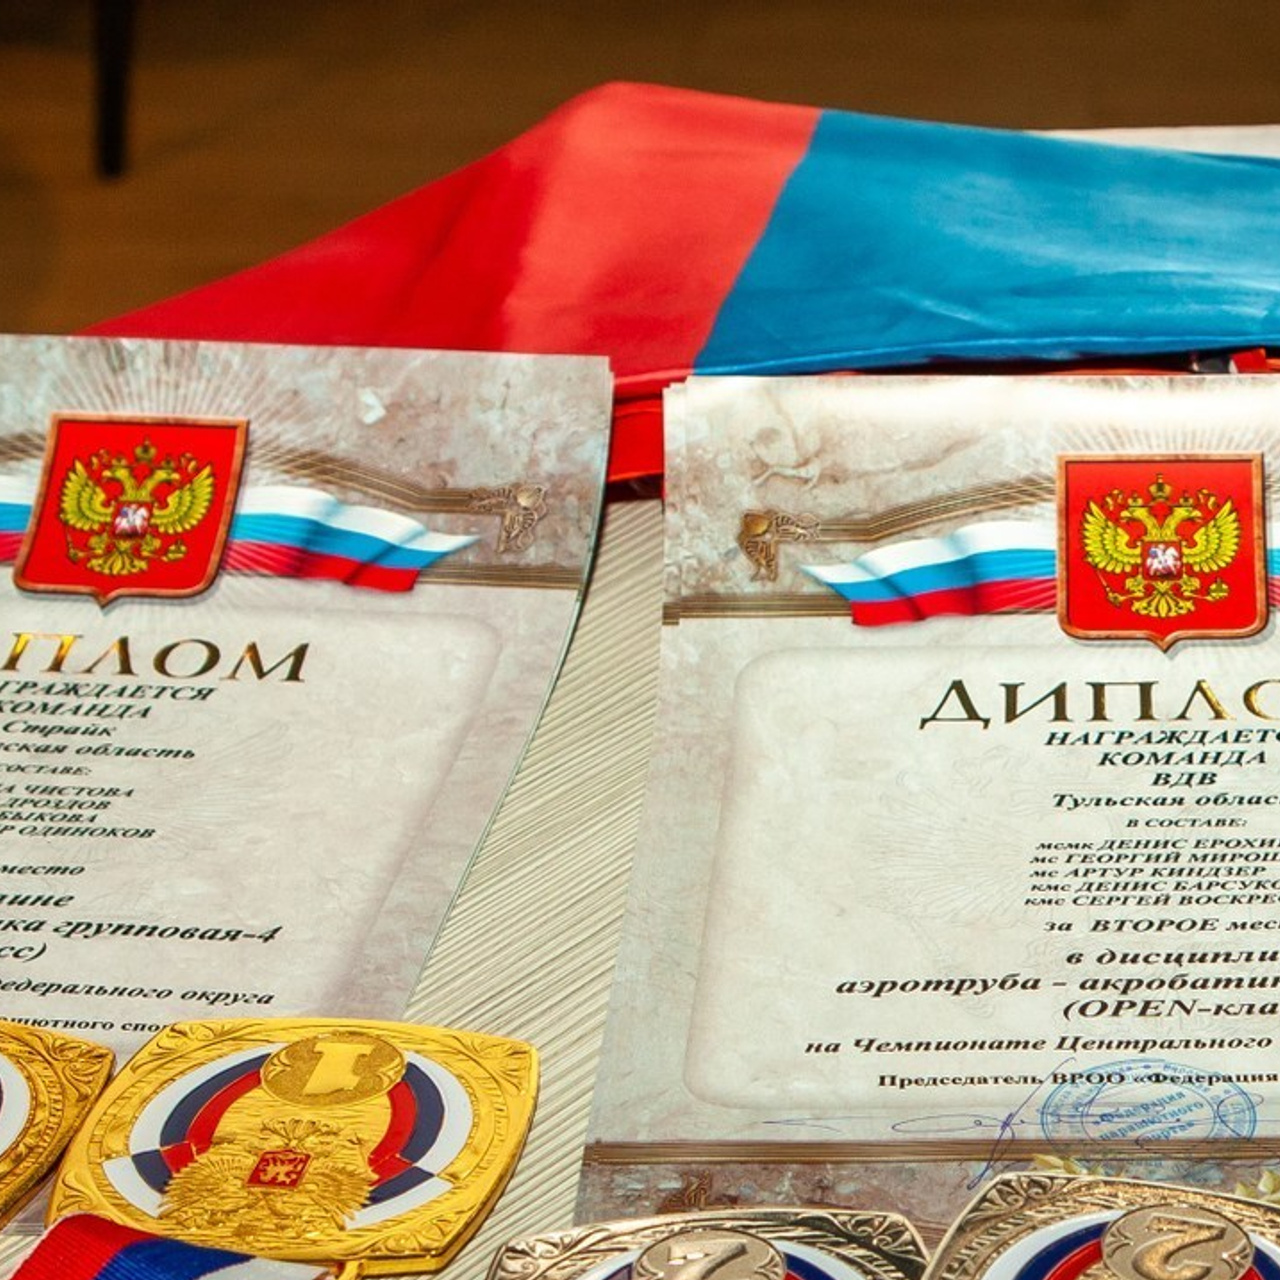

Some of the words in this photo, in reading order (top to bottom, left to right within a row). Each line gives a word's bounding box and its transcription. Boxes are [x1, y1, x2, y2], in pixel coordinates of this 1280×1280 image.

[2, 720, 117, 738] Страйк
[0, 742, 68, 755] ская
[75, 743, 196, 759] область
[1097, 751, 1266, 767] КОМАНДА
[1151, 772, 1217, 788] ВДВ
[24, 784, 135, 798] ЧИСТОВА
[1052, 793, 1184, 810] Тульская
[1145, 818, 1248, 828] СОСТАВЕ:
[18, 825, 156, 838] ОДИНОКОВ
[1035, 842, 1093, 850] мсмк
[1096, 839, 1187, 851] ДЕНИС
[1029, 856, 1058, 864] мс
[1064, 851, 1180, 864] ГЕОРГИЙ
[1029, 870, 1058, 878] мс
[1064, 868, 1144, 878] АРТУР
[1151, 866, 1266, 878] КИНДЗЕР
[1030, 884, 1071, 892] кмс
[1075, 881, 1167, 893] ДЕНИС
[1024, 898, 1065, 906] кмс
[1072, 894, 1170, 906] СЕРГЕЙ
[0, 919, 47, 932] ка
[53, 920, 283, 943] групповая-4
[1043, 922, 1072, 933] за
[1090, 918, 1219, 933] ВТОРОЕ
[1066, 952, 1083, 964] в
[0, 977, 173, 1000] едерального
[181, 989, 275, 1006] округа
[836, 974, 1042, 997] аэротруба
[806, 1040, 841, 1054] на
[854, 1037, 1046, 1054] Чемпионате
[1054, 1035, 1273, 1055] Центрального
[878, 1074, 1043, 1089] Председатель
[1052, 1073, 1126, 1086] ВРОО
[1133, 1071, 1279, 1087] «Федерация
